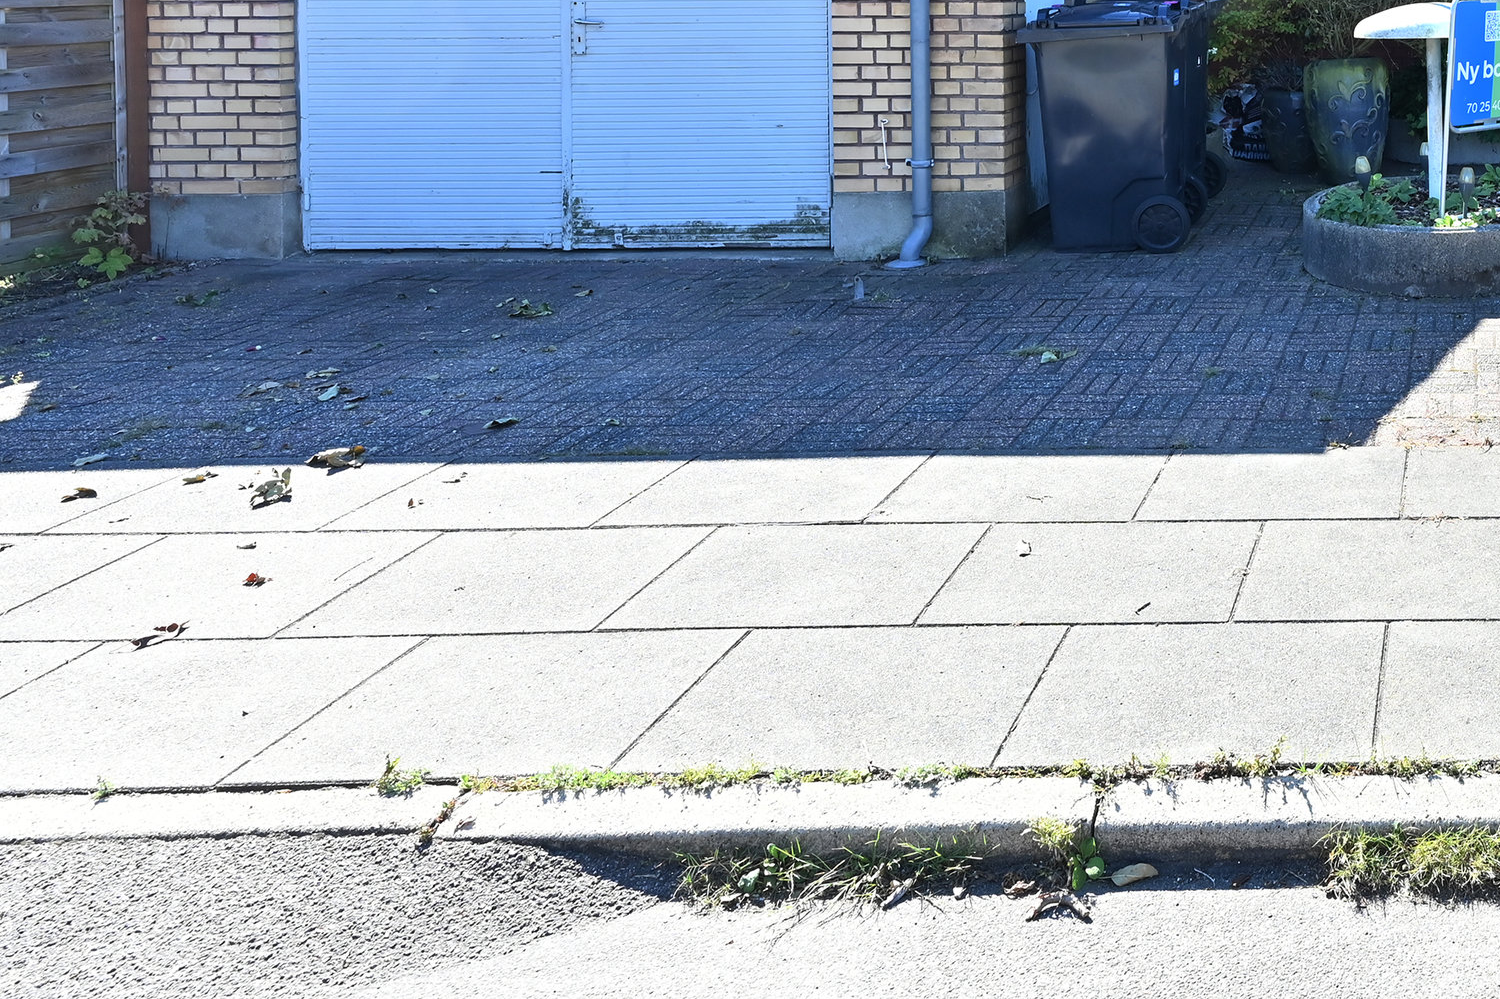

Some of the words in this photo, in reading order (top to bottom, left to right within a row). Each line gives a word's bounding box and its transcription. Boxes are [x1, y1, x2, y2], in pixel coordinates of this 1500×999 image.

[1457, 62, 1480, 85] Ny
[1466, 103, 1478, 114] 70
[1480, 101, 1491, 113] 25
